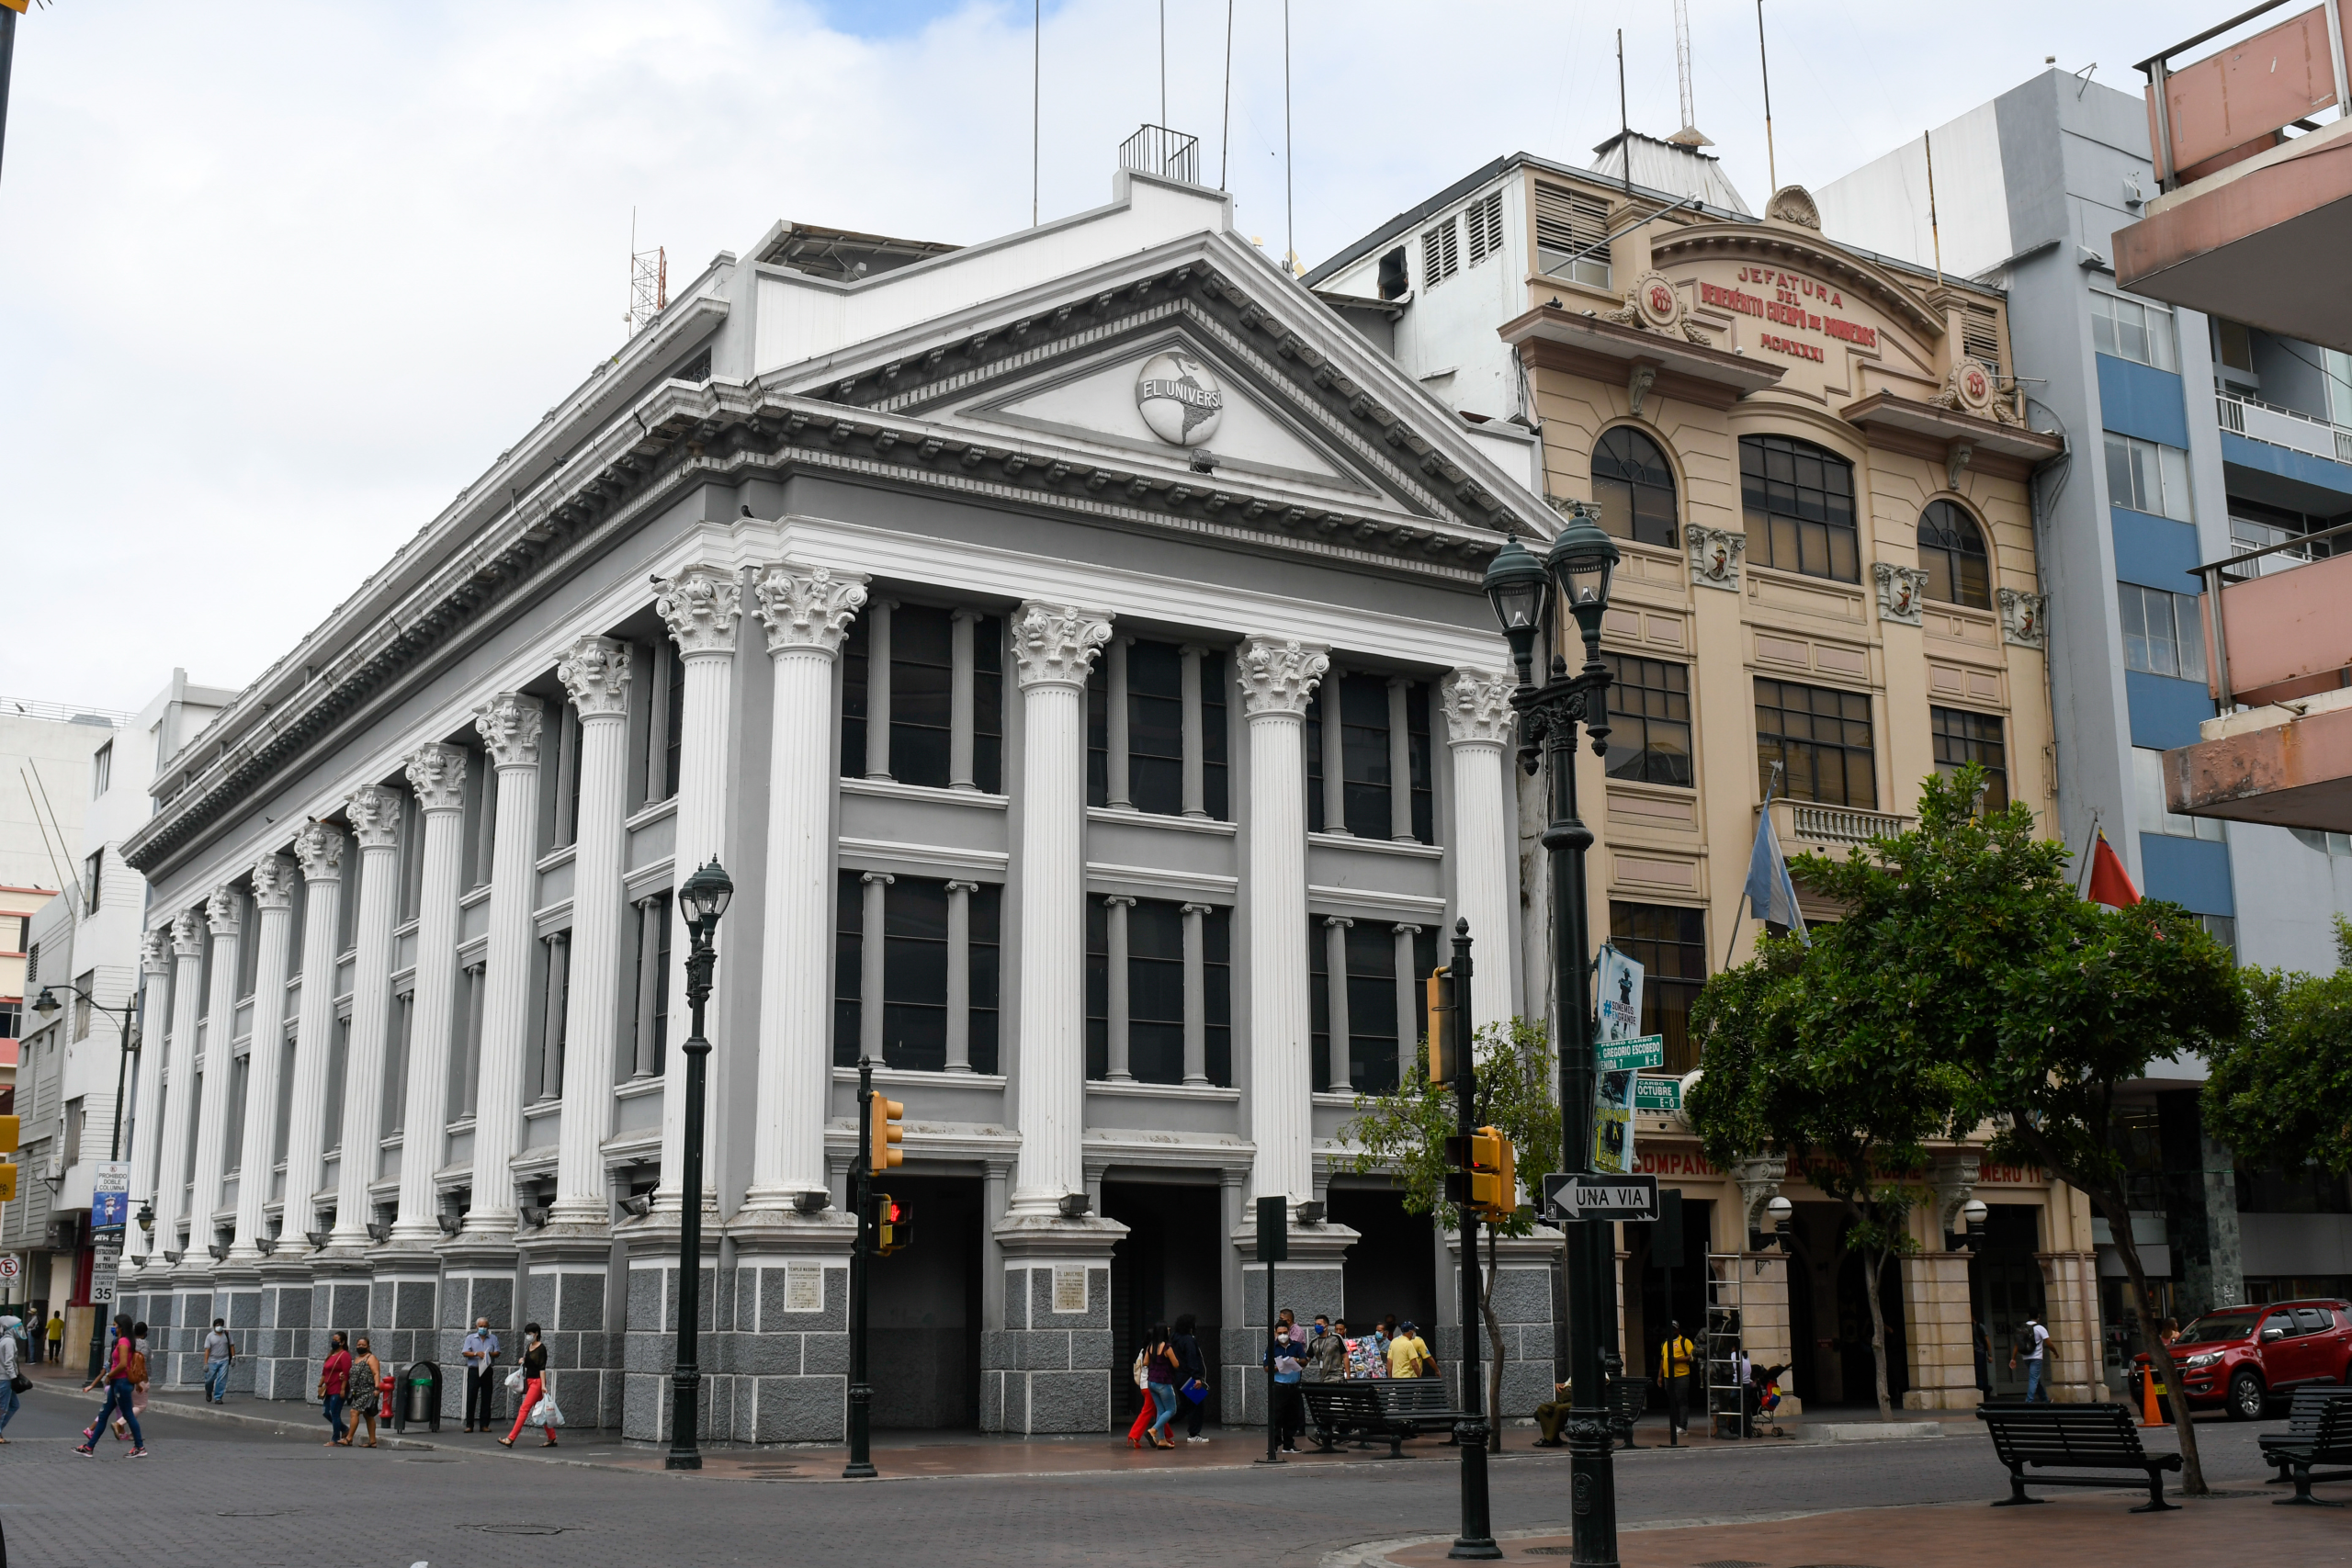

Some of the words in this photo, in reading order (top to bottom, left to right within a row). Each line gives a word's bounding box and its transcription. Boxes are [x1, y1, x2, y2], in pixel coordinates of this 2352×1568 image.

[1737, 266, 1843, 309] JEFATURA
[1776, 288, 1801, 307] DEL
[1701, 281, 1764, 318] BENEMÉRITO
[1767, 300, 1806, 329] CUERPO
[1808, 313, 1821, 331] DE
[1824, 315, 1876, 348] BOMBEROS
[1760, 333, 1824, 363] MCMXXXI
[1143, 380, 1161, 399] EL
[1166, 380, 1223, 408] UNIVERSO
[1603, 1045, 1631, 1058] GREGORIO
[1632, 1042, 1660, 1055] ESCOBEDO
[1619, 1058, 1623, 1068] 7
[1637, 1086, 1672, 1096] OCTUBRE
[1596, 1107, 1631, 1122] GUAYAQUIL
[1612, 1124, 1619, 1140] A
[1595, 1123, 1601, 1161] 1
[1601, 1150, 1622, 1168] AÑO
[1576, 1189, 1610, 1205] UNA
[1617, 1189, 1644, 1205] VIA
[95, 1288, 112, 1300] 35
